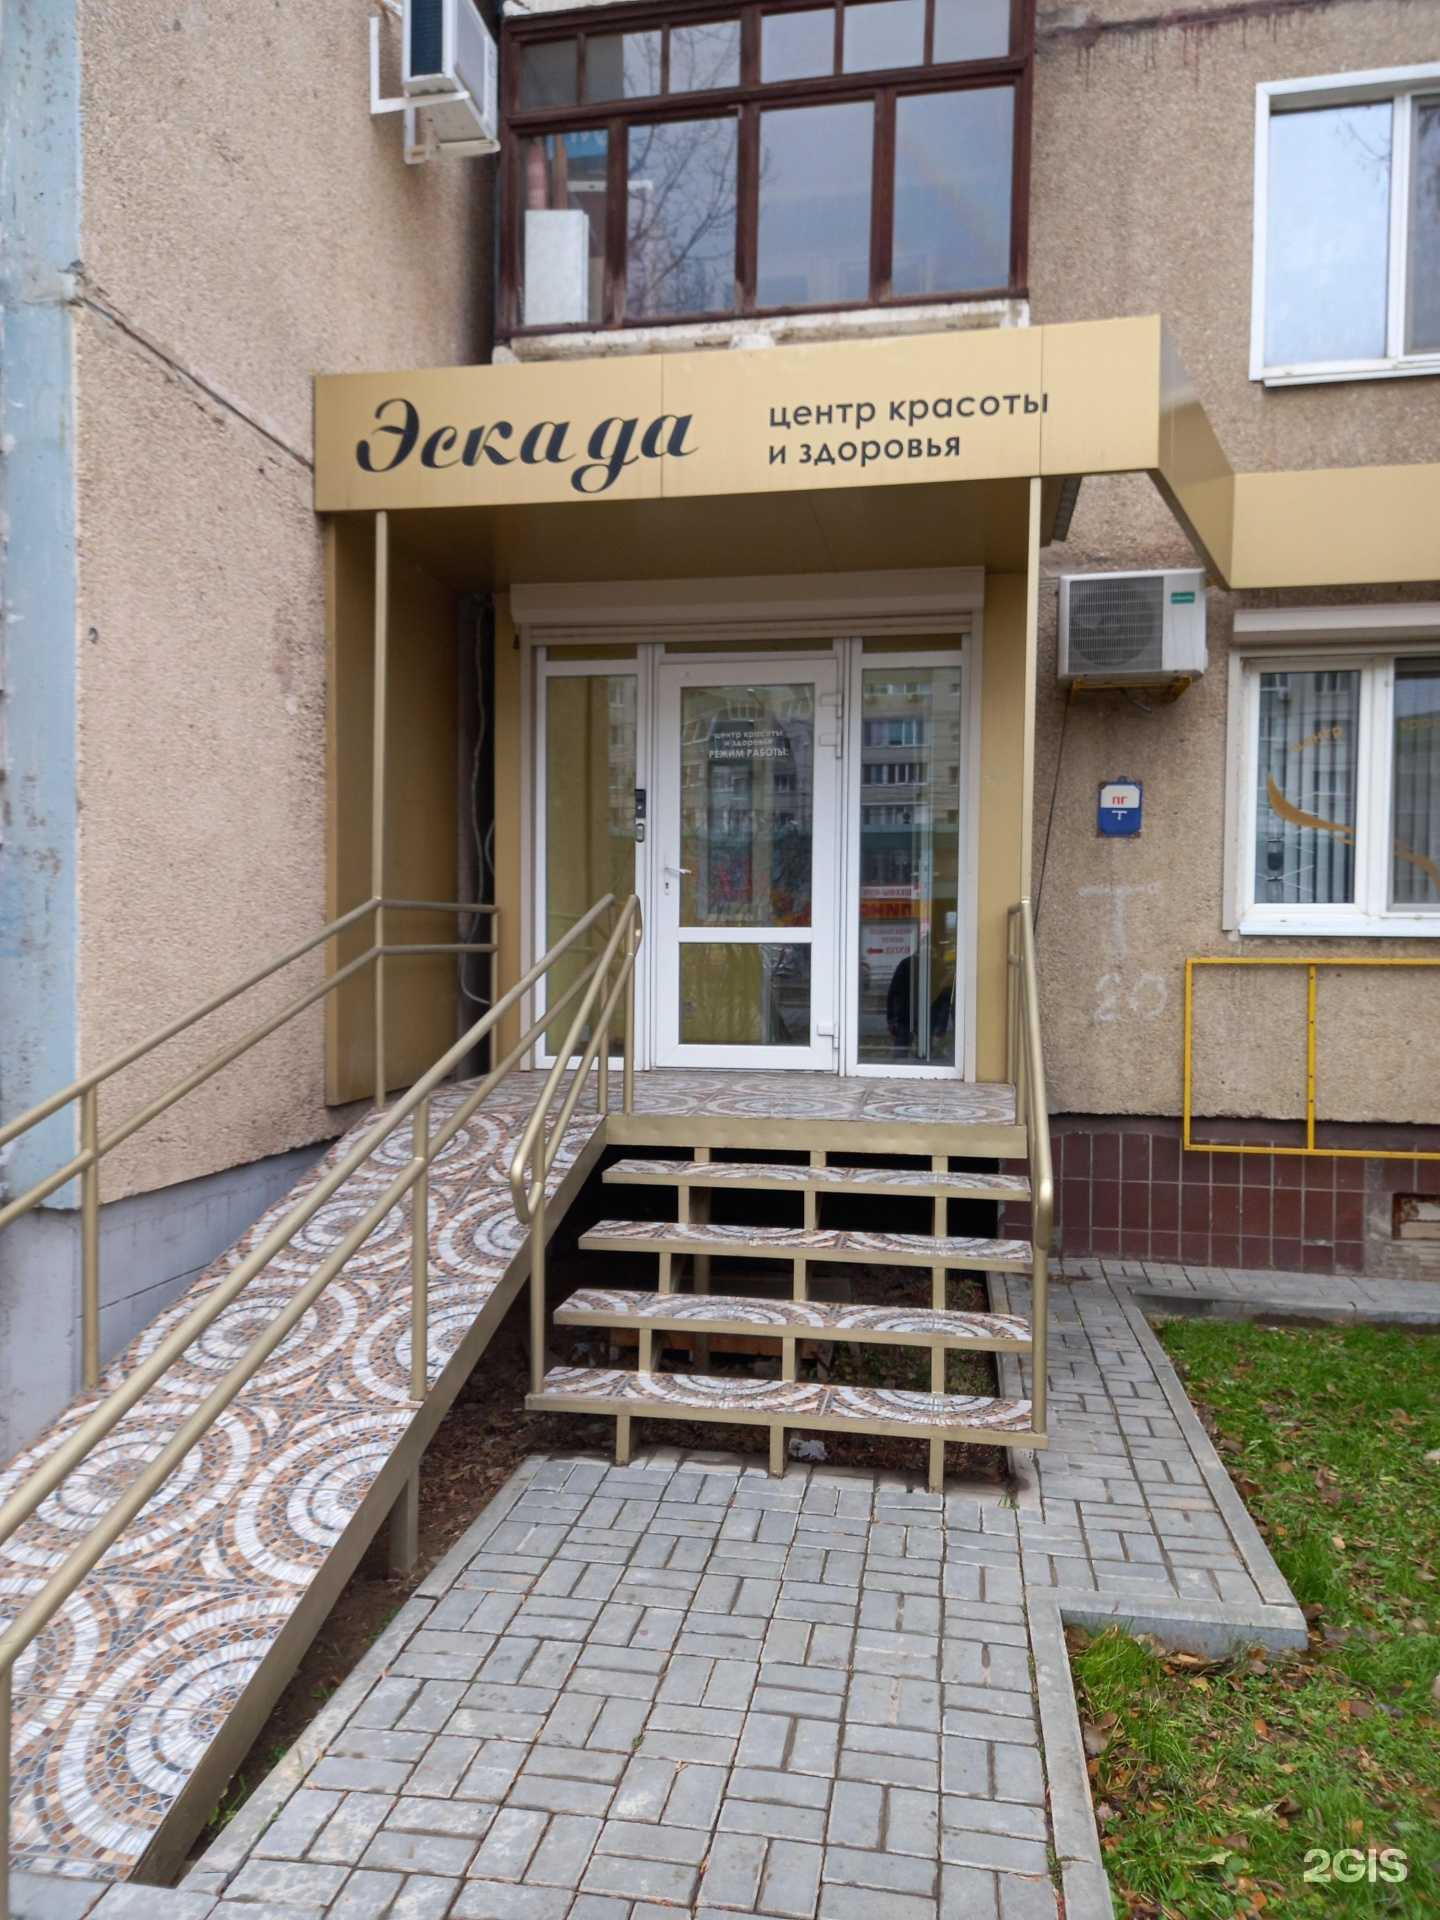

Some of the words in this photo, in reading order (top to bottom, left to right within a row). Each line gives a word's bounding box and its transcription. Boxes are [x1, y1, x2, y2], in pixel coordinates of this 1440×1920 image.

[769, 401, 876, 429] центр
[889, 393, 1048, 426] красоты
[356, 398, 699, 493] Эскада
[769, 445, 786, 464] и
[798, 436, 960, 467] здоровья
